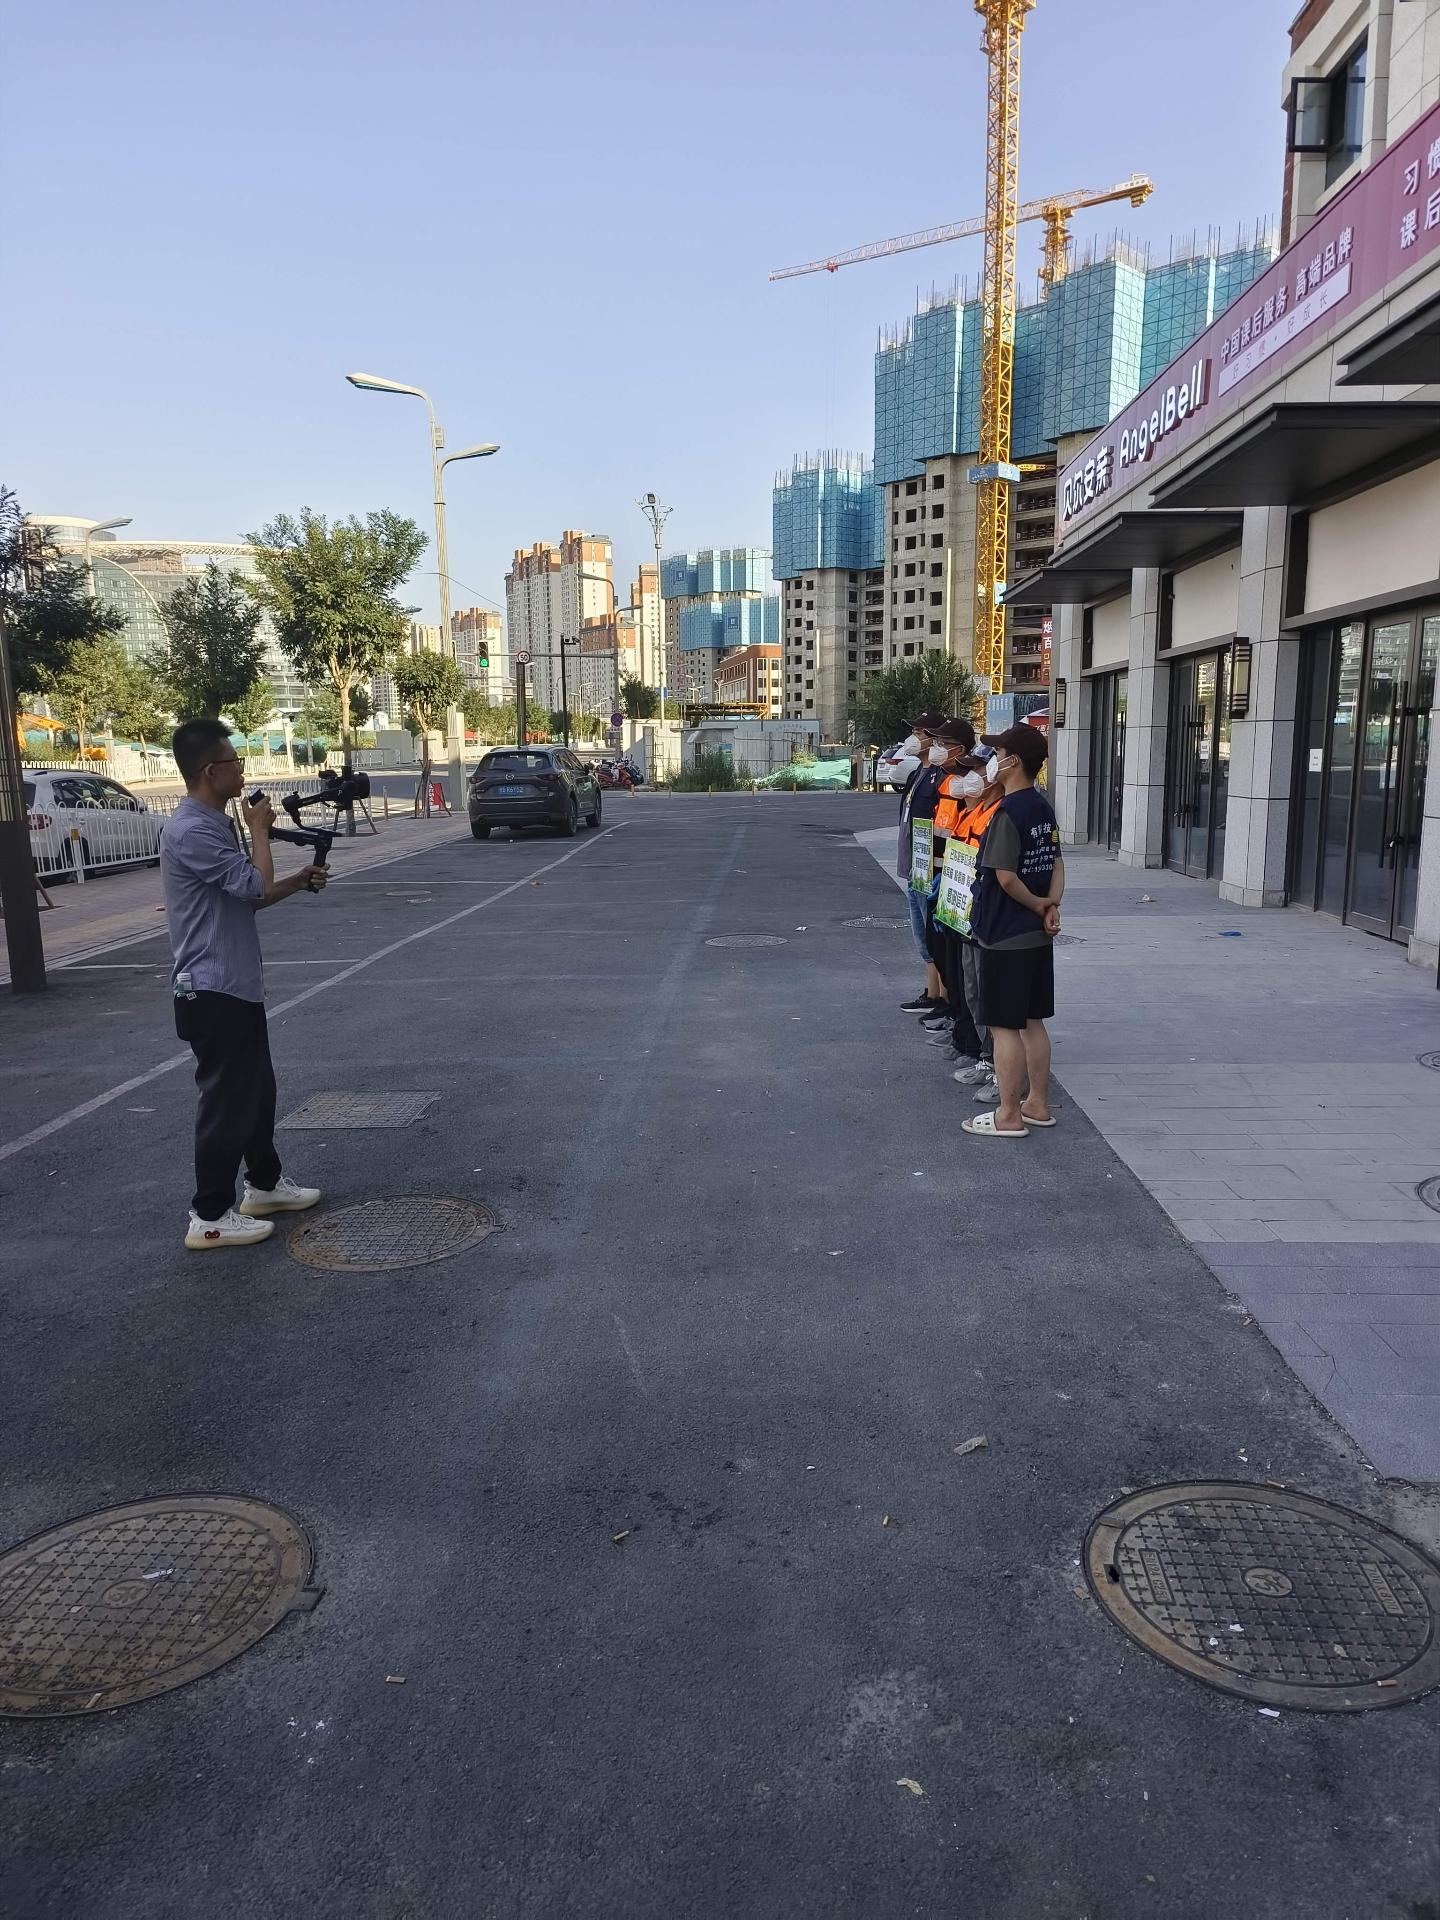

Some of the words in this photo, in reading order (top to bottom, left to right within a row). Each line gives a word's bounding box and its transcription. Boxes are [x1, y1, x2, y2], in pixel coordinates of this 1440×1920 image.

[1221, 285, 1289, 364] 中国课后服务
[1296, 225, 1354, 301] 高端品牌
[1062, 445, 1109, 520] 贝尔安亲
[1119, 358, 1204, 468] AngelBell
